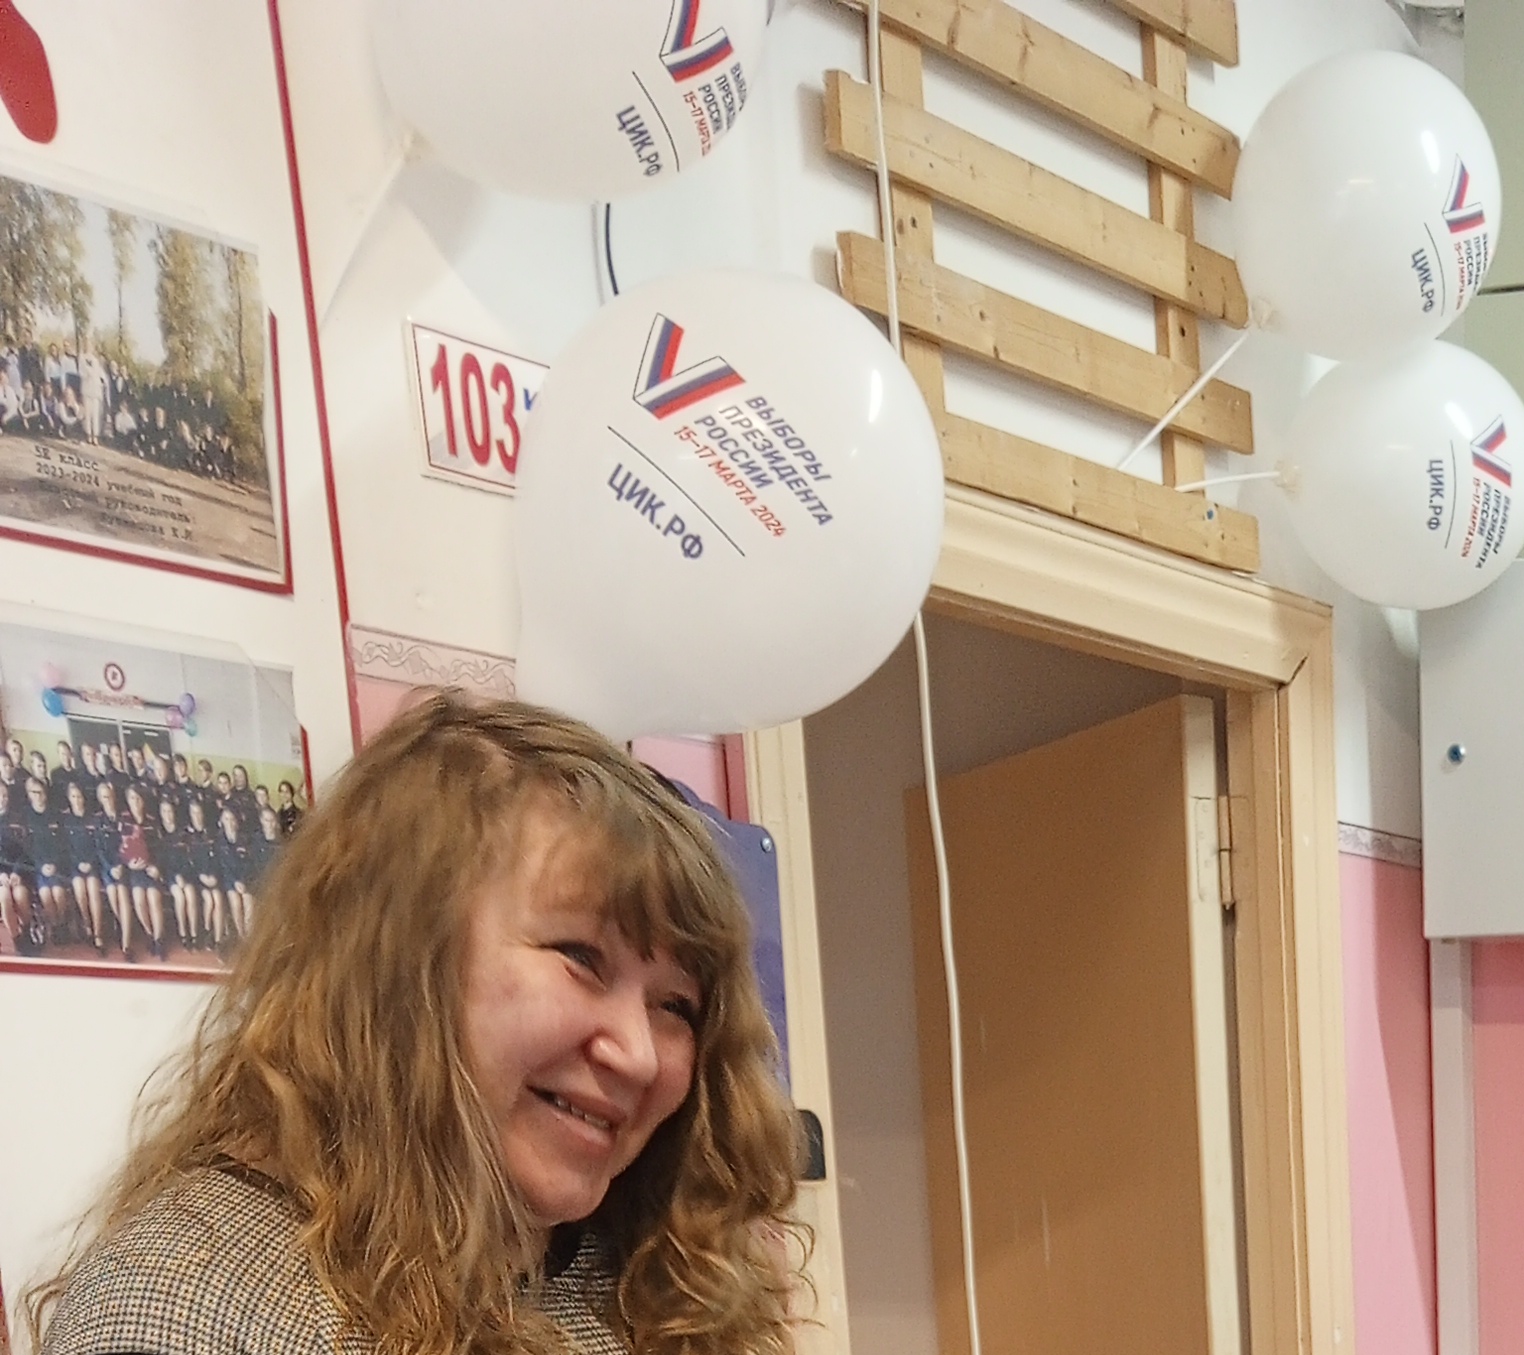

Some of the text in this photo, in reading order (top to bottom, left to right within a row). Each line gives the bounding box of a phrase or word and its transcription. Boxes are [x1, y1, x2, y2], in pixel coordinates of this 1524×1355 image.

[616, 105, 663, 177] ЦИК.РФ
[1411, 247, 1436, 313] ЦИК.РФ
[430, 343, 521, 475] 103
[745, 396, 832, 482] ВЫБОРЫ
[694, 415, 774, 489] РОССИИ
[719, 405, 833, 526] ПРЕЗИДЕНТА
[607, 463, 704, 559] ЦИК.РФ
[708, 460, 757, 506] МАРТА
[751, 505, 787, 537] 2024
[1426, 459, 1445, 530] ЦИК.РФ
[1477, 481, 1492, 537] РОССИИ
